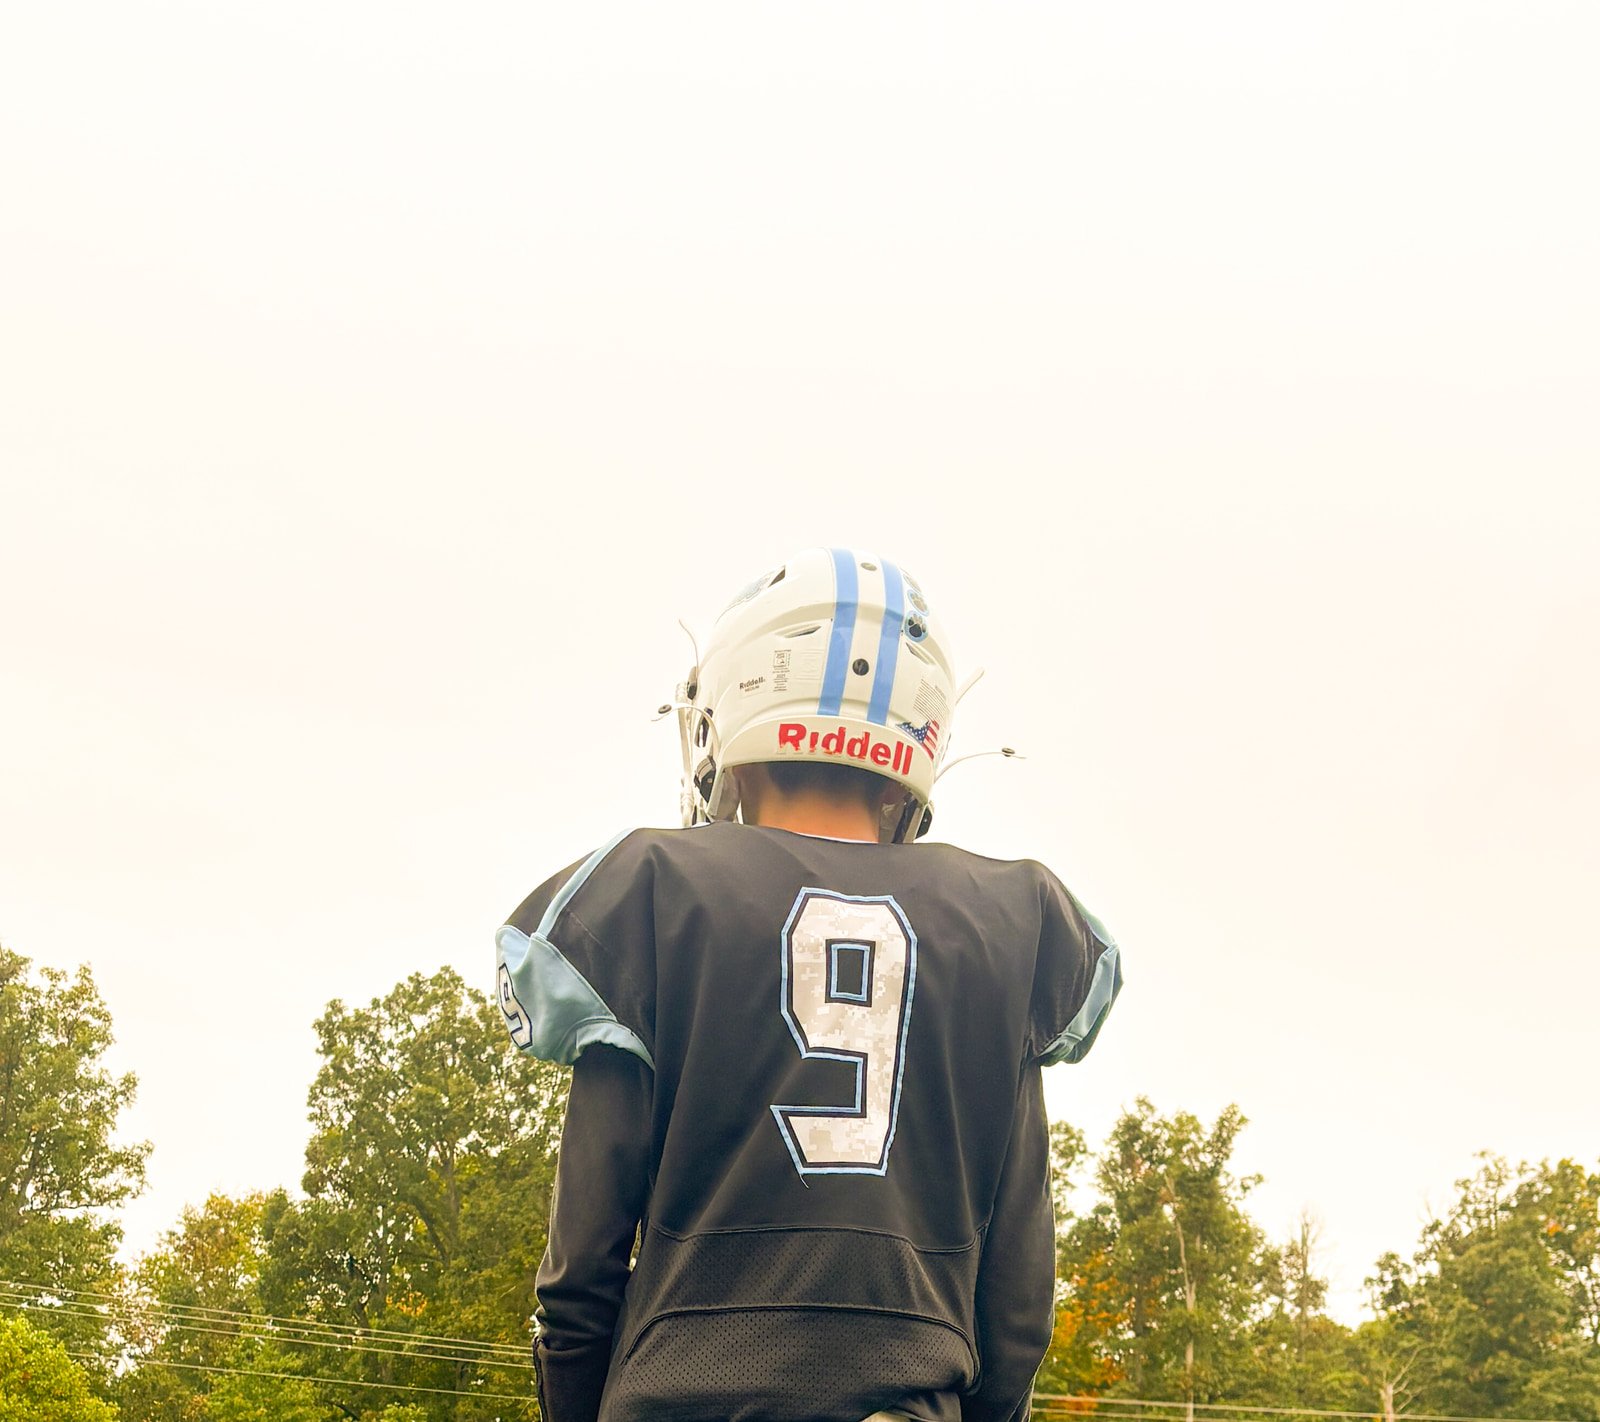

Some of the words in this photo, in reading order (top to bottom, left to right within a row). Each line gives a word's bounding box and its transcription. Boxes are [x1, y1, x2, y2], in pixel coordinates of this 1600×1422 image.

[778, 723, 914, 775] Riddell
[498, 962, 533, 1050] 9
[770, 887, 918, 1176] 9
